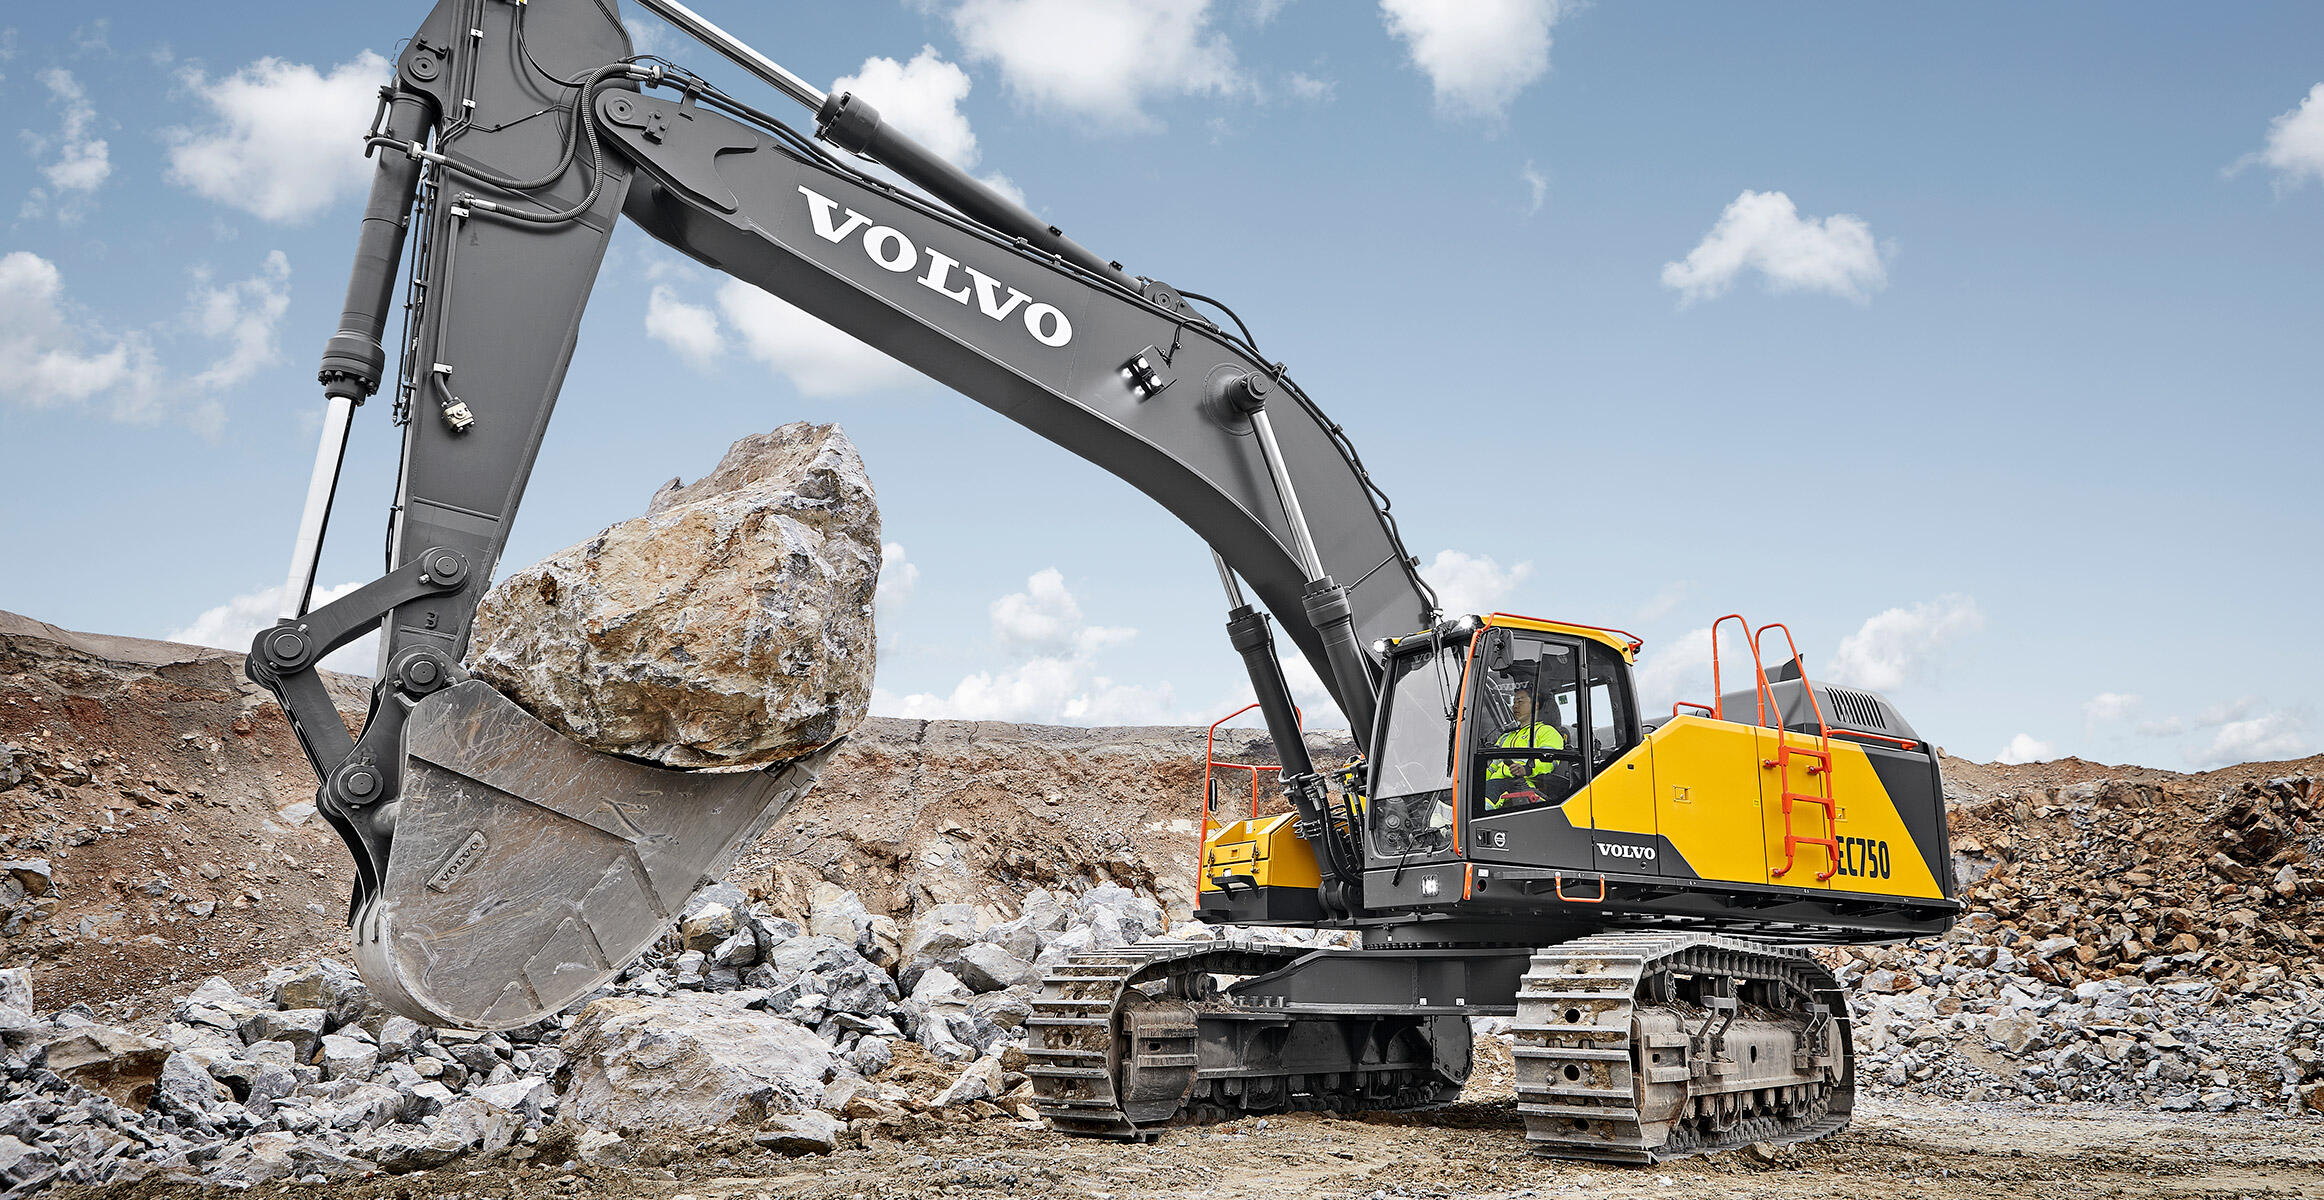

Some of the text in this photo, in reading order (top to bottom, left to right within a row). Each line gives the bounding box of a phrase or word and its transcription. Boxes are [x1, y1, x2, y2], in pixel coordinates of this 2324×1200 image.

[798, 185, 1073, 347] VOLVO
[440, 842, 480, 881] VOLVO
[1596, 842, 1656, 860] VOLVO
[1836, 836, 1890, 879] EC750
